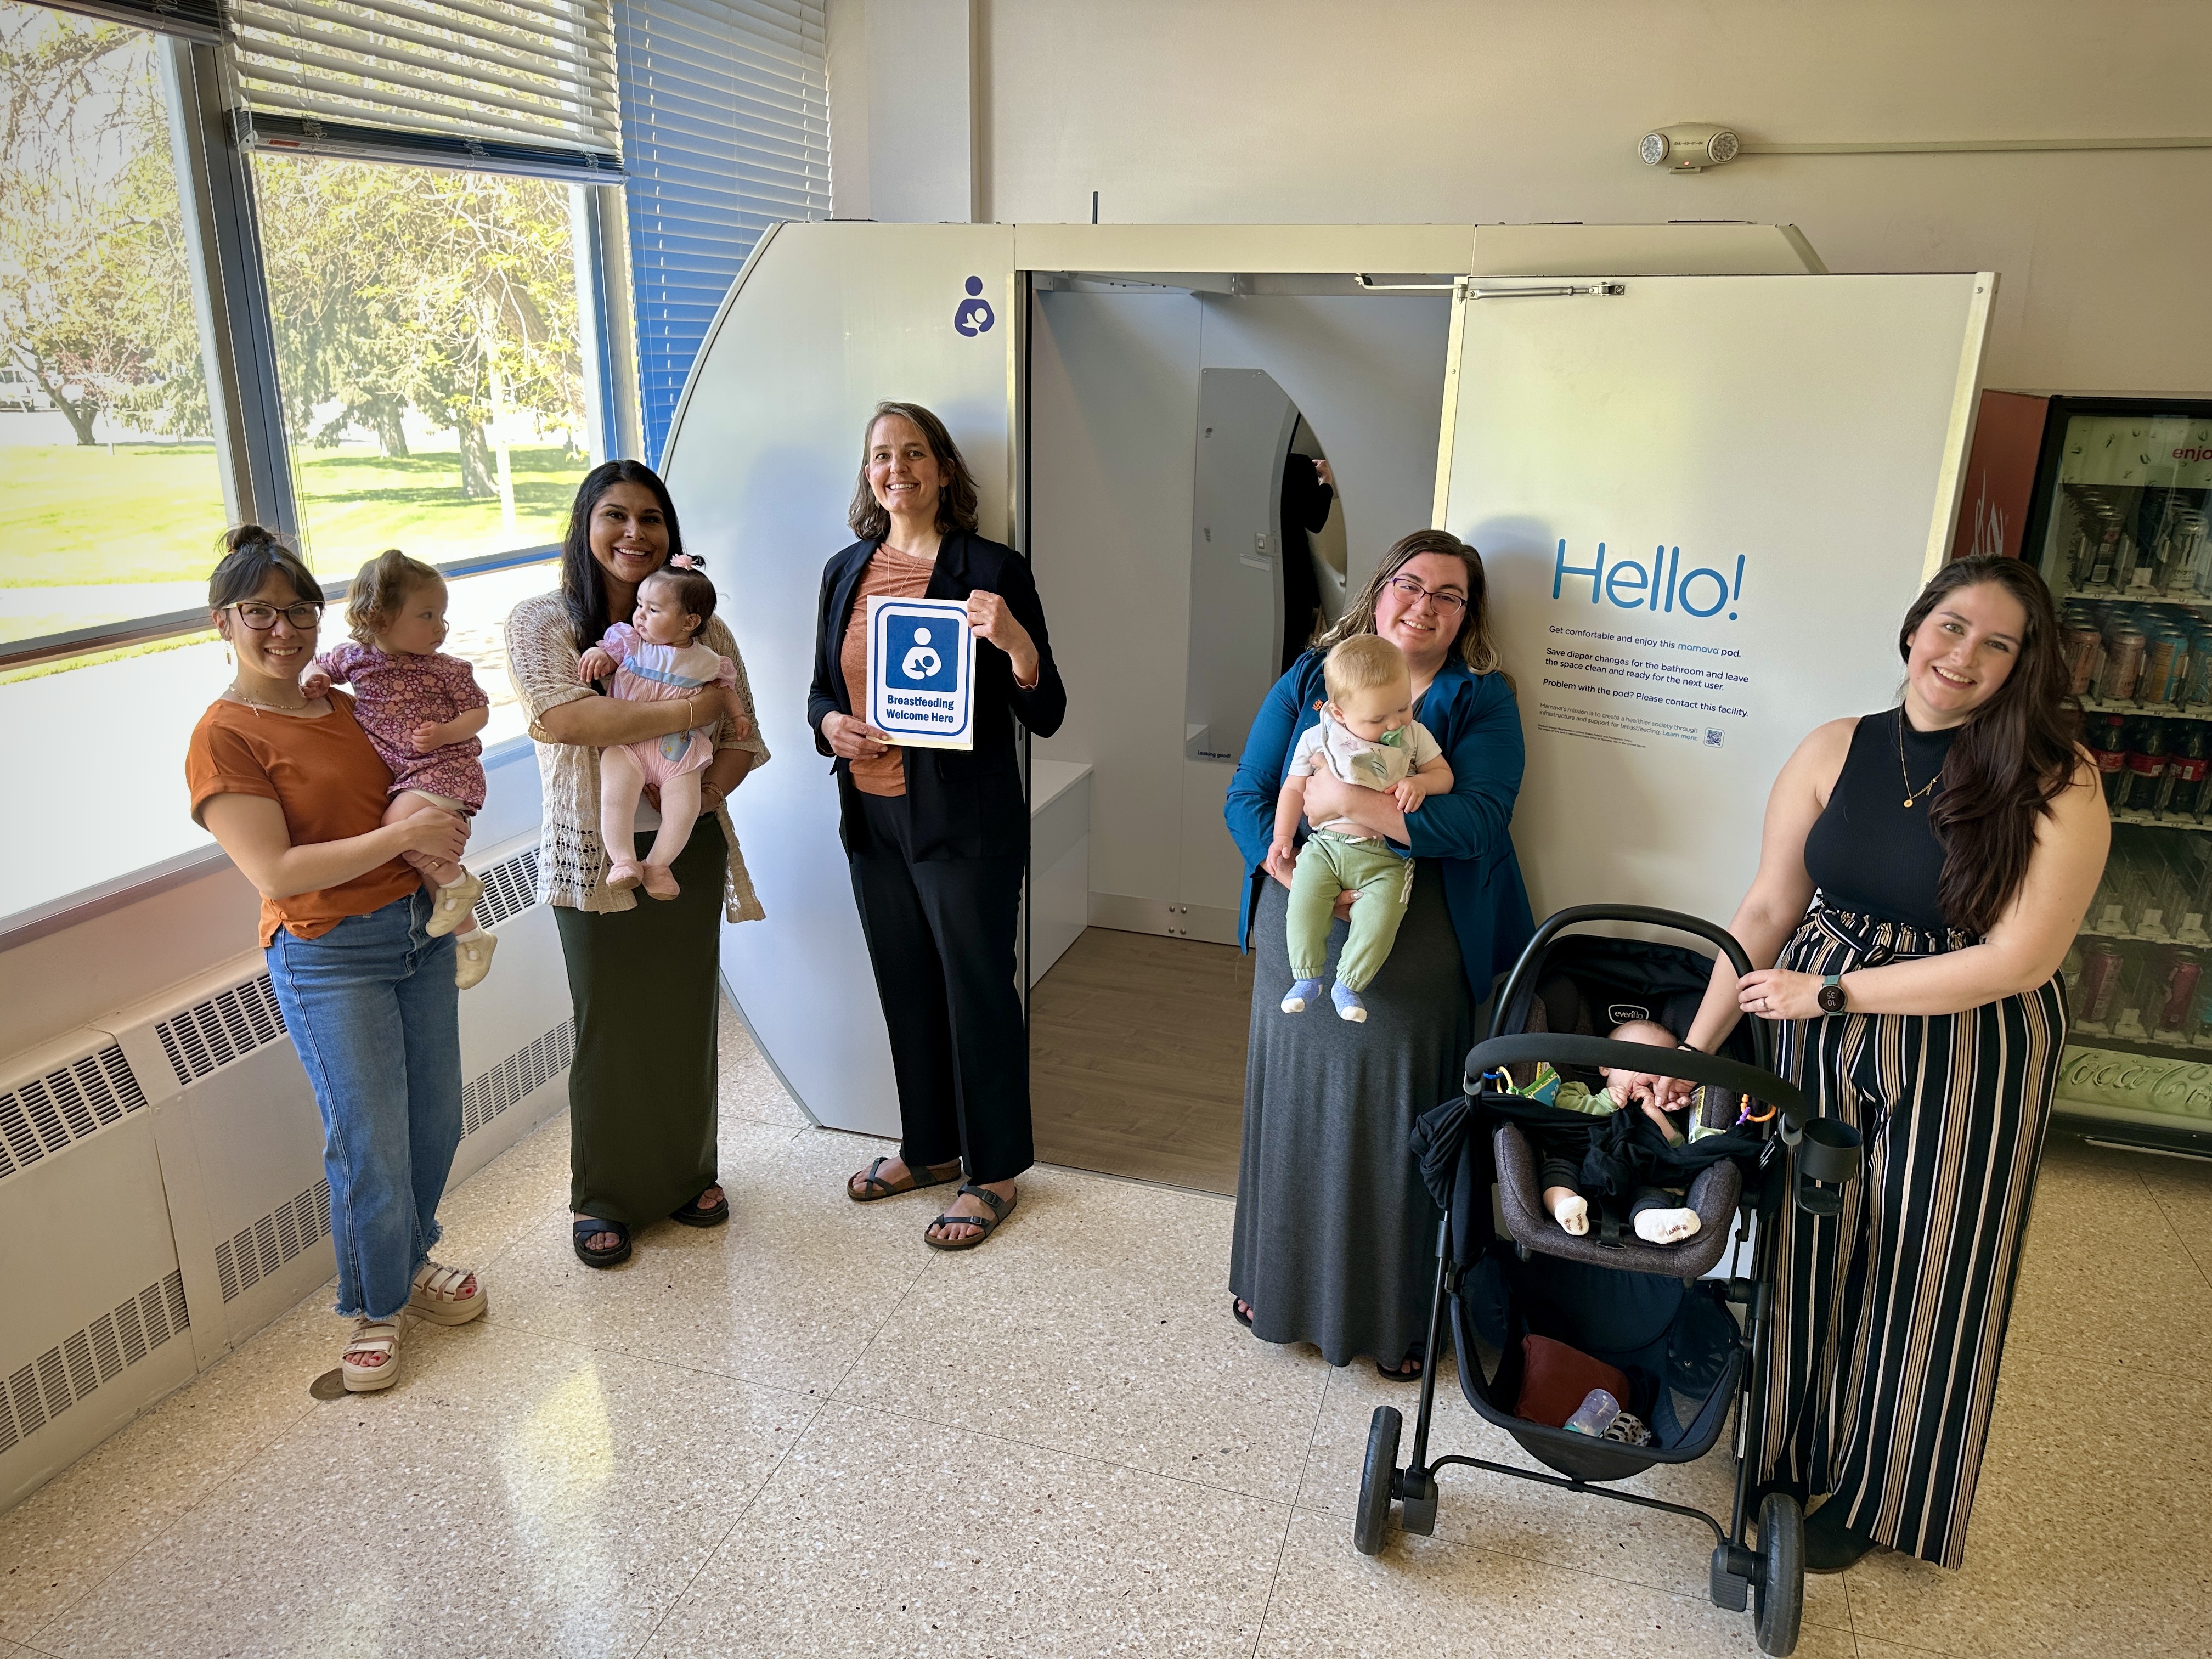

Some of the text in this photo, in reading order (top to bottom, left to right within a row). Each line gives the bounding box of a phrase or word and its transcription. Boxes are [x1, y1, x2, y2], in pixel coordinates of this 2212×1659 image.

[2172, 445, 2212, 462] enjo
[1553, 538, 1746, 621] Hello!
[1549, 625, 1563, 634] Get
[1565, 629, 1615, 640] comfortable
[1634, 637, 1657, 647] enjoy
[1660, 640, 1675, 648] this
[1721, 649, 1741, 657] pod.
[1546, 647, 1565, 657] Save
[1567, 651, 1593, 660] diaper
[1595, 654, 1629, 665] changes
[1632, 659, 1643, 667] for
[1645, 661, 1659, 669] the
[1661, 663, 1704, 676] bathroom
[1725, 672, 1749, 683] leave
[1560, 662, 1583, 670] space
[1585, 664, 1606, 673] clean
[1627, 670, 1650, 680] ready
[1652, 673, 1664, 681] for
[1667, 675, 1680, 684] the
[1683, 679, 1702, 687] next
[1704, 682, 1724, 691] user.
[887, 694, 955, 710] Breastfeeding
[1543, 678, 1748, 718] Problem with the pod? Please contact this facility.
[886, 709, 954, 723] Welcome Here
[1539, 709, 1575, 720] infrastructure
[1540, 702, 1566, 712] Mamava's
[1626, 716, 1651, 725] healthier
[1651, 721, 1673, 730] society
[1674, 725, 1698, 733] through
[1615, 1010, 1643, 1019] evenflo
